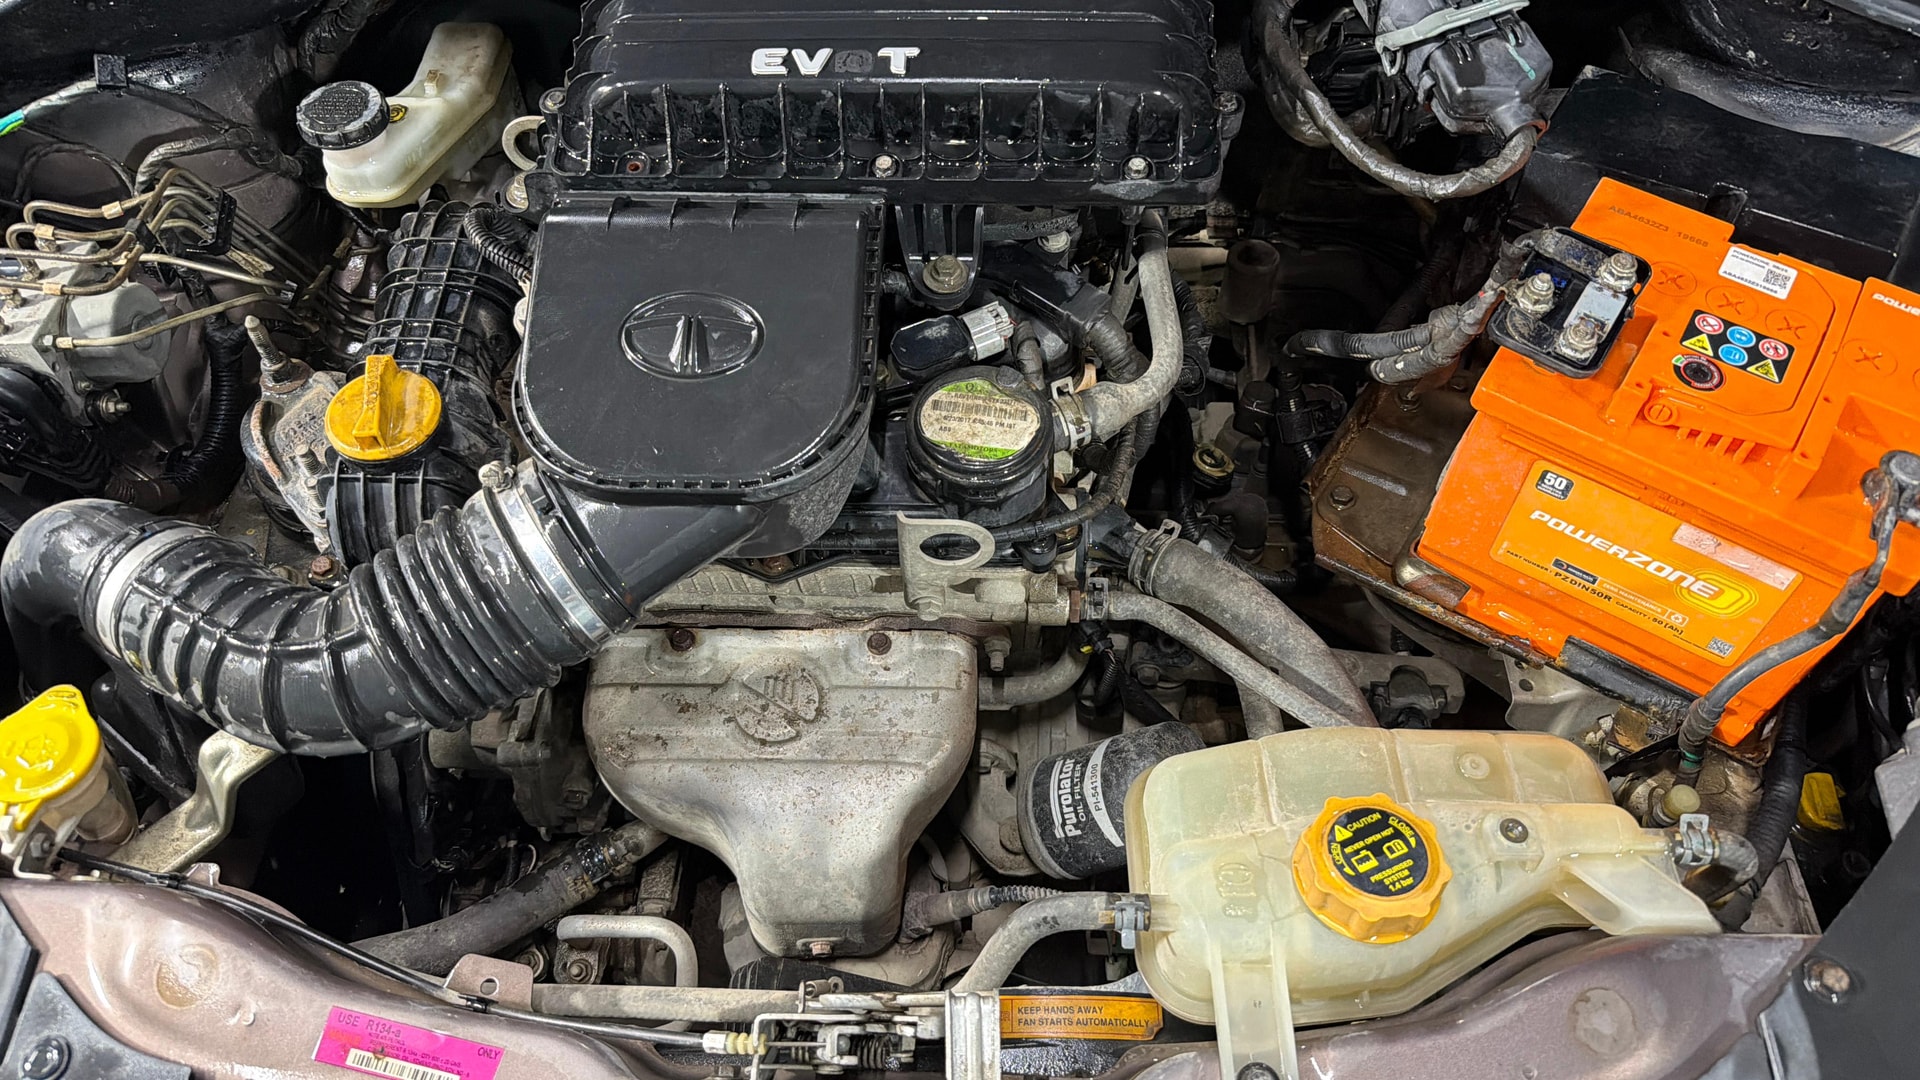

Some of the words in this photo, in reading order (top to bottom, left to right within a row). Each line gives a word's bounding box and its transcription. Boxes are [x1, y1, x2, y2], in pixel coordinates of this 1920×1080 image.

[1543, 472, 1567, 491] 50
[1529, 510, 1721, 599] POWERZONE
[1506, 549, 1522, 561] PART
[1554, 570, 1613, 603] PZDIN50R
[1615, 601, 1648, 619] CAPACITY
[1074, 763, 1082, 799] FILTER
[1090, 763, 1103, 812] PI-541300
[1059, 758, 1082, 837] Purolator
[1077, 802, 1087, 822] OIL
[1346, 812, 1382, 832] CAUTION
[1364, 833, 1382, 845] OPEN
[1381, 827, 1395, 838] HOT
[1388, 816, 1415, 836] CLOSE
[1383, 869, 1410, 886] SYSTEM
[1401, 877, 1414, 887] bar
[1017, 1006, 1041, 1015] KEEP
[1044, 1006, 1075, 1015] HANDS
[1077, 1006, 1104, 1015] AWAY
[1017, 1018, 1036, 1027] FAN
[1038, 1017, 1073, 1026] STARTS
[1076, 1018, 1150, 1028] AUTOMATICALLY
[337, 1011, 360, 1028] USE
[477, 1046, 501, 1061] ONLY
